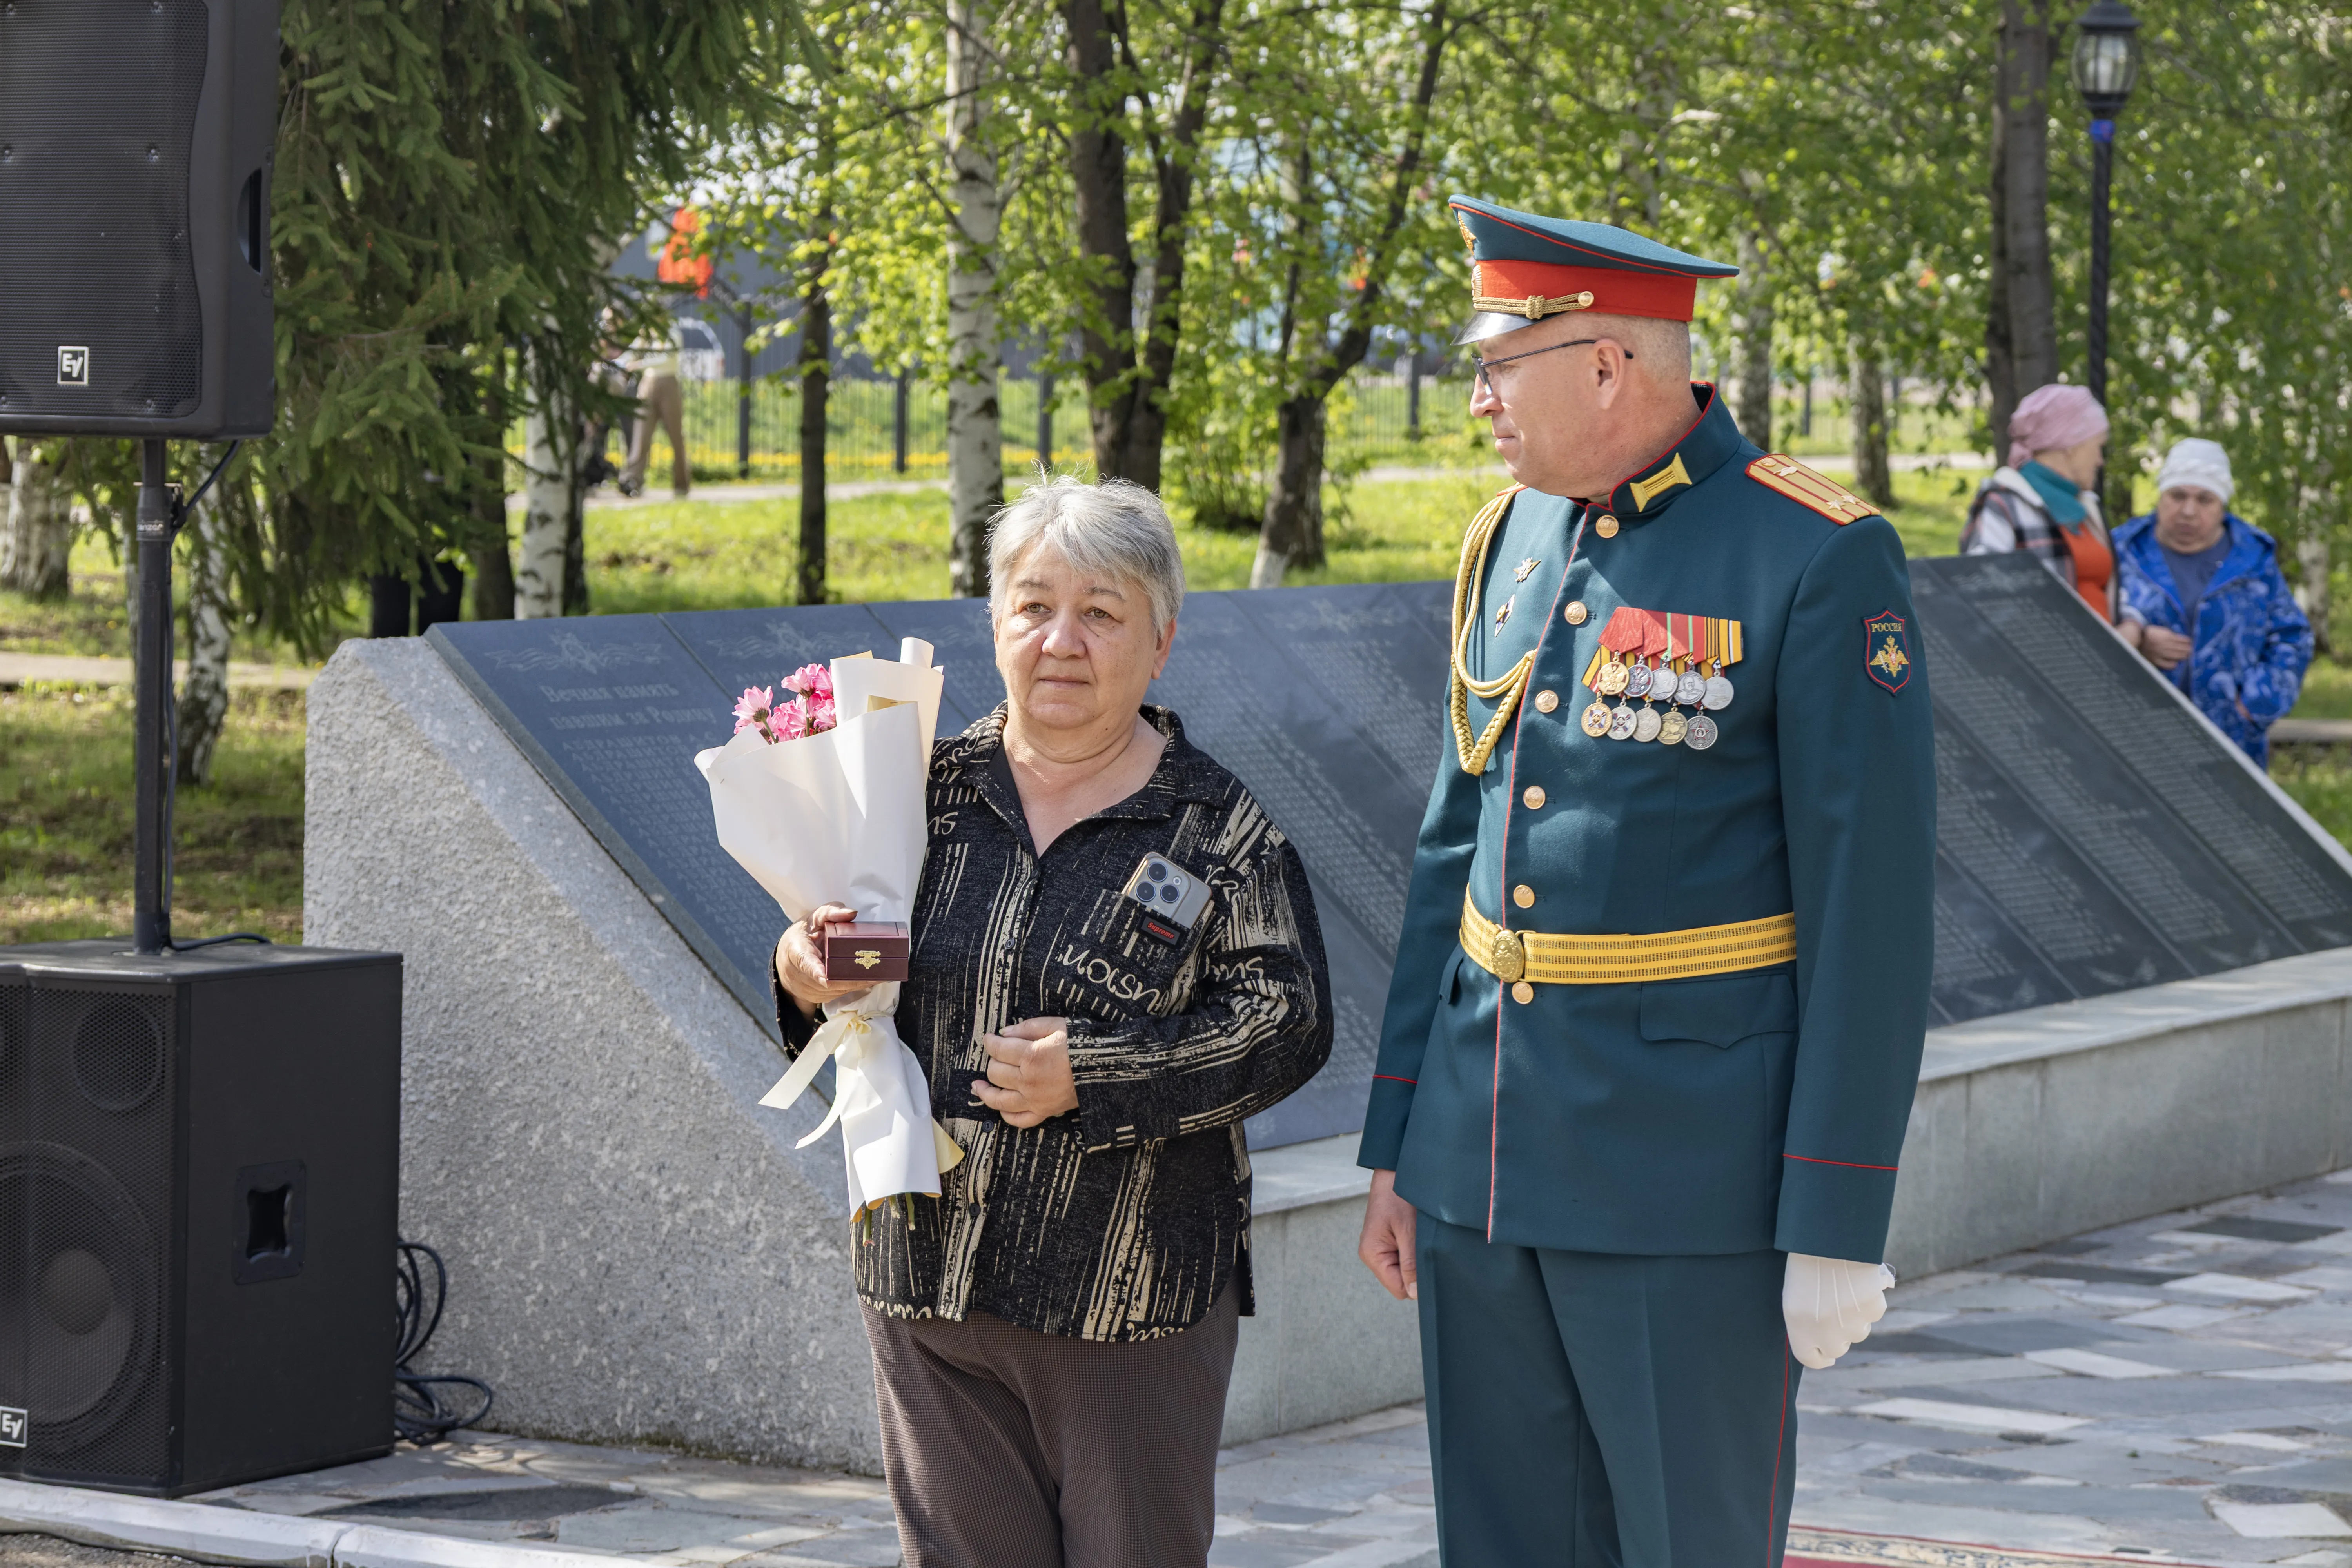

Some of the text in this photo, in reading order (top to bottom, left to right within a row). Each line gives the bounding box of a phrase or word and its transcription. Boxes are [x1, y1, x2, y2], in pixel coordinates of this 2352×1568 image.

[539, 683, 679, 703] Вечная память
[548, 706, 717, 730] павшим за Родину
[1147, 921, 1175, 939] Supreme
